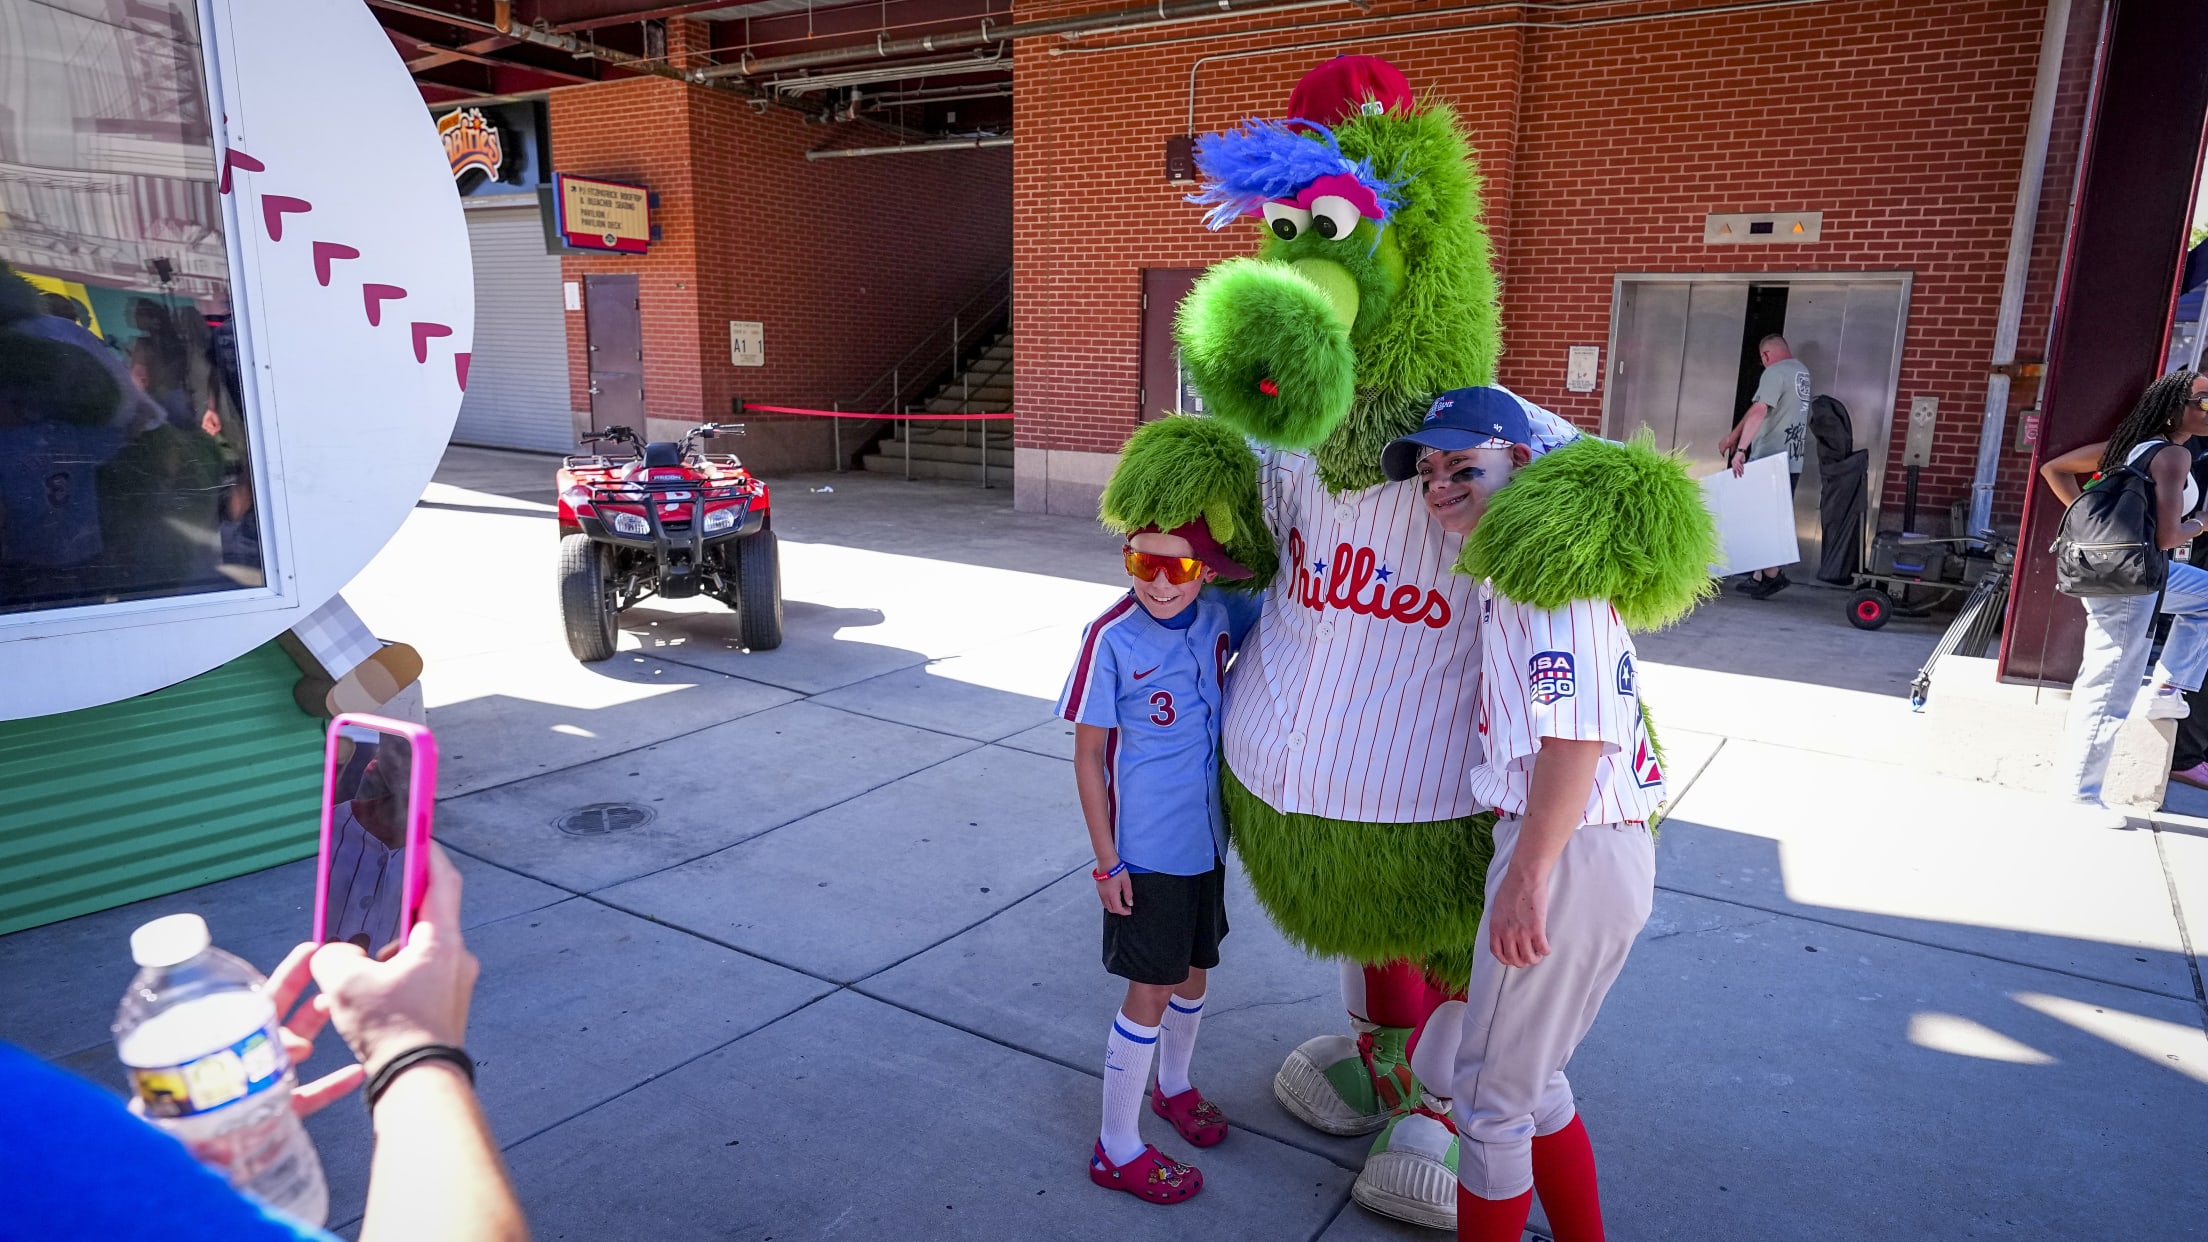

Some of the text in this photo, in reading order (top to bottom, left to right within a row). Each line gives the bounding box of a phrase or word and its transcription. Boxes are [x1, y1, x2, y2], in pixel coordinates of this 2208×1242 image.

[581, 208, 606, 218] PAVILION
[587, 197, 613, 208] BLEACHER
[615, 201, 635, 211] SEATING
[581, 219, 606, 228] PAVILION
[733, 338, 762, 354] A1 1
[1288, 527, 1452, 629] Phillies
[1530, 656, 1571, 676] USA
[1530, 678, 1574, 702] 250
[1149, 690, 1176, 727] 3
